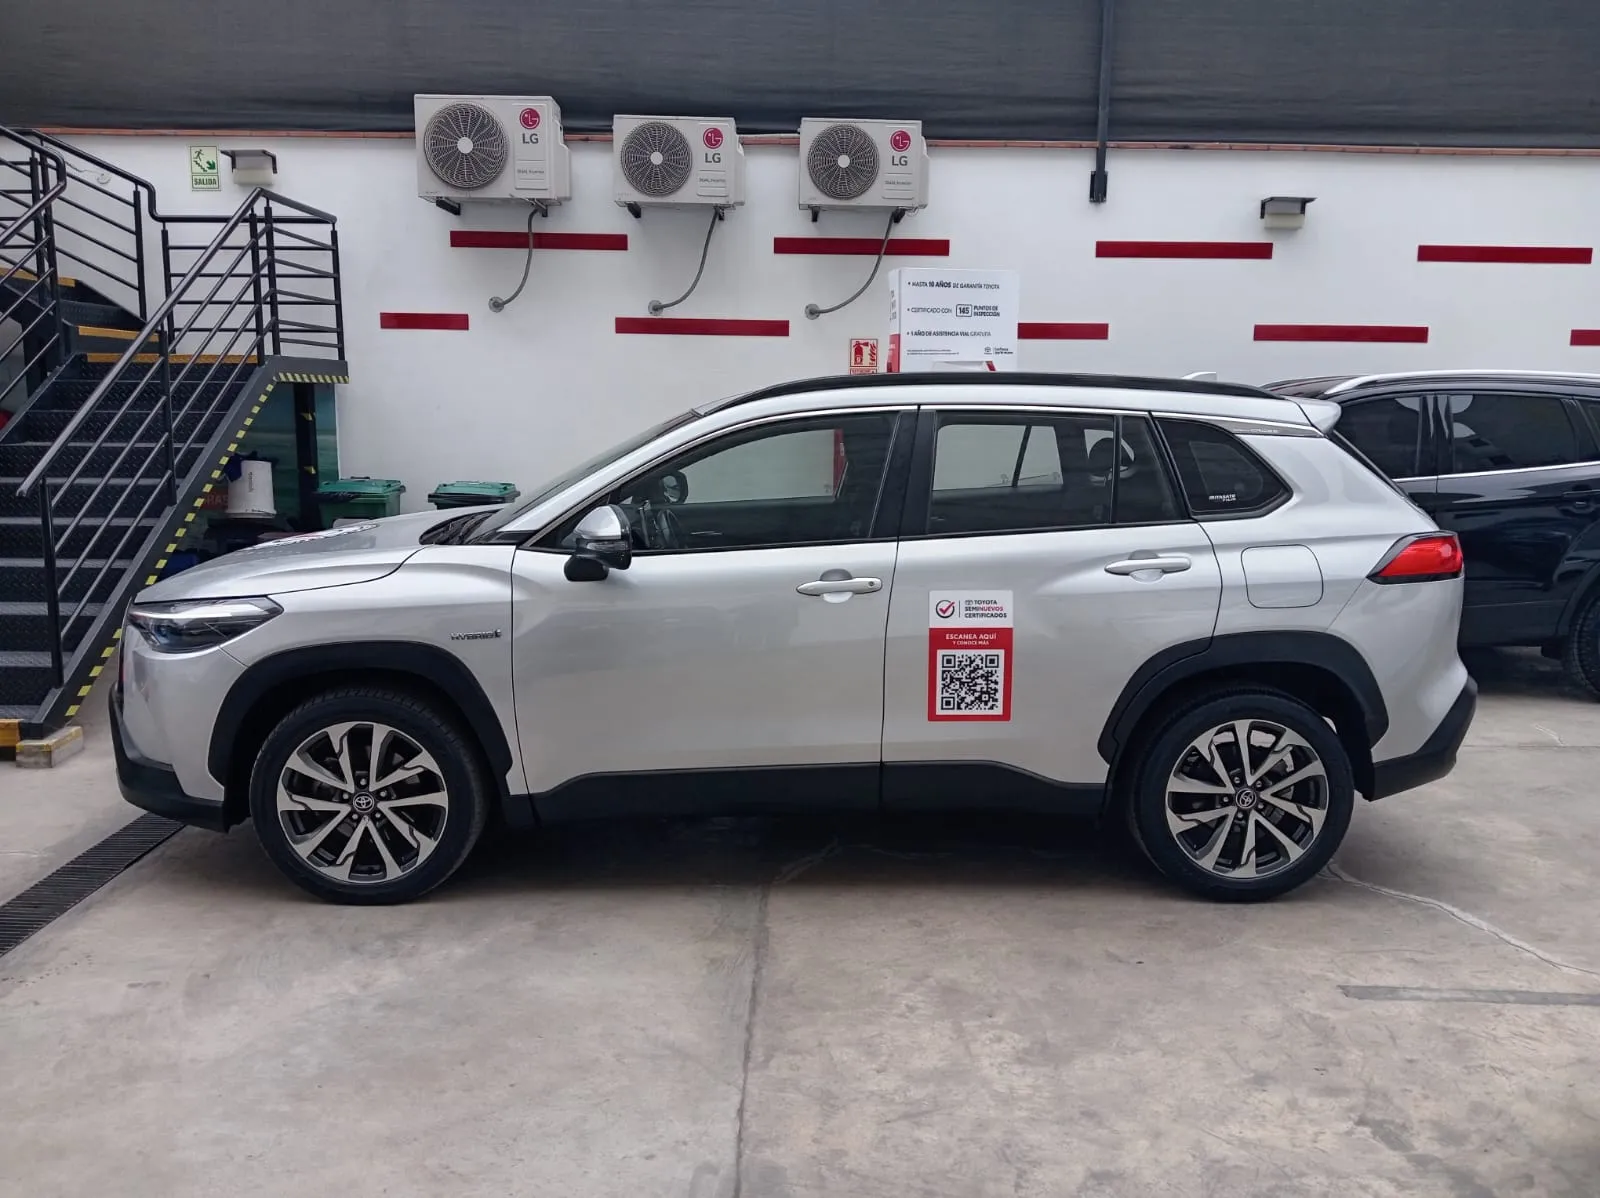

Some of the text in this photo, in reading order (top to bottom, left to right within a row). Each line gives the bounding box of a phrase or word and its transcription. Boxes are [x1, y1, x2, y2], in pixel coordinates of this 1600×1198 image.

[522, 133, 539, 145] LG
[704, 152, 722, 164] LG
[891, 155, 909, 167] LG
[194, 178, 217, 186] SALIDA
[929, 280, 935, 288] 10
[935, 280, 952, 288] AÑOS
[959, 306, 970, 315] 145
[914, 329, 926, 337] AÑO
[978, 632, 997, 640] AQUÍ
